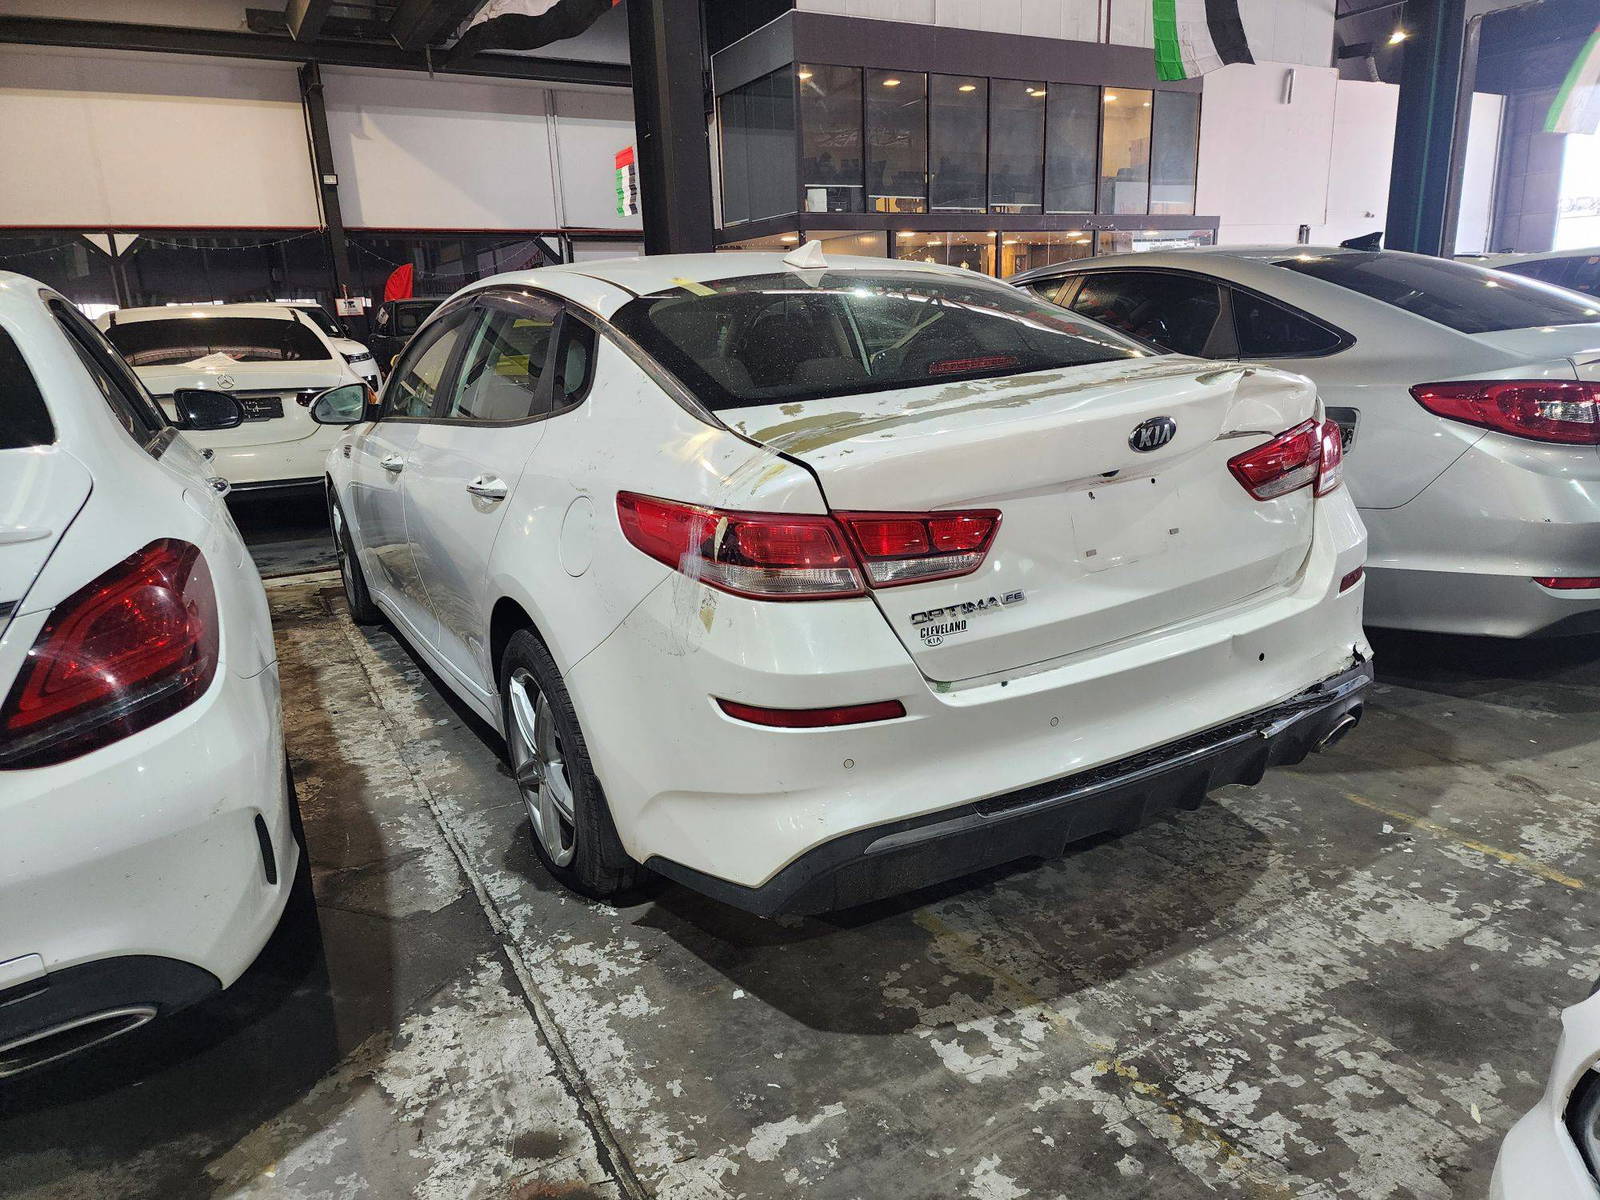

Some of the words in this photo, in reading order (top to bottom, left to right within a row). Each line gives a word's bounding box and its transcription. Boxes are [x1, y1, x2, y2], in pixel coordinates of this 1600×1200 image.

[1139, 424, 1171, 447] KIA
[911, 596, 1000, 625] OPTIMA
[1005, 591, 1023, 602] FE
[920, 620, 967, 638] CLEVELAND
